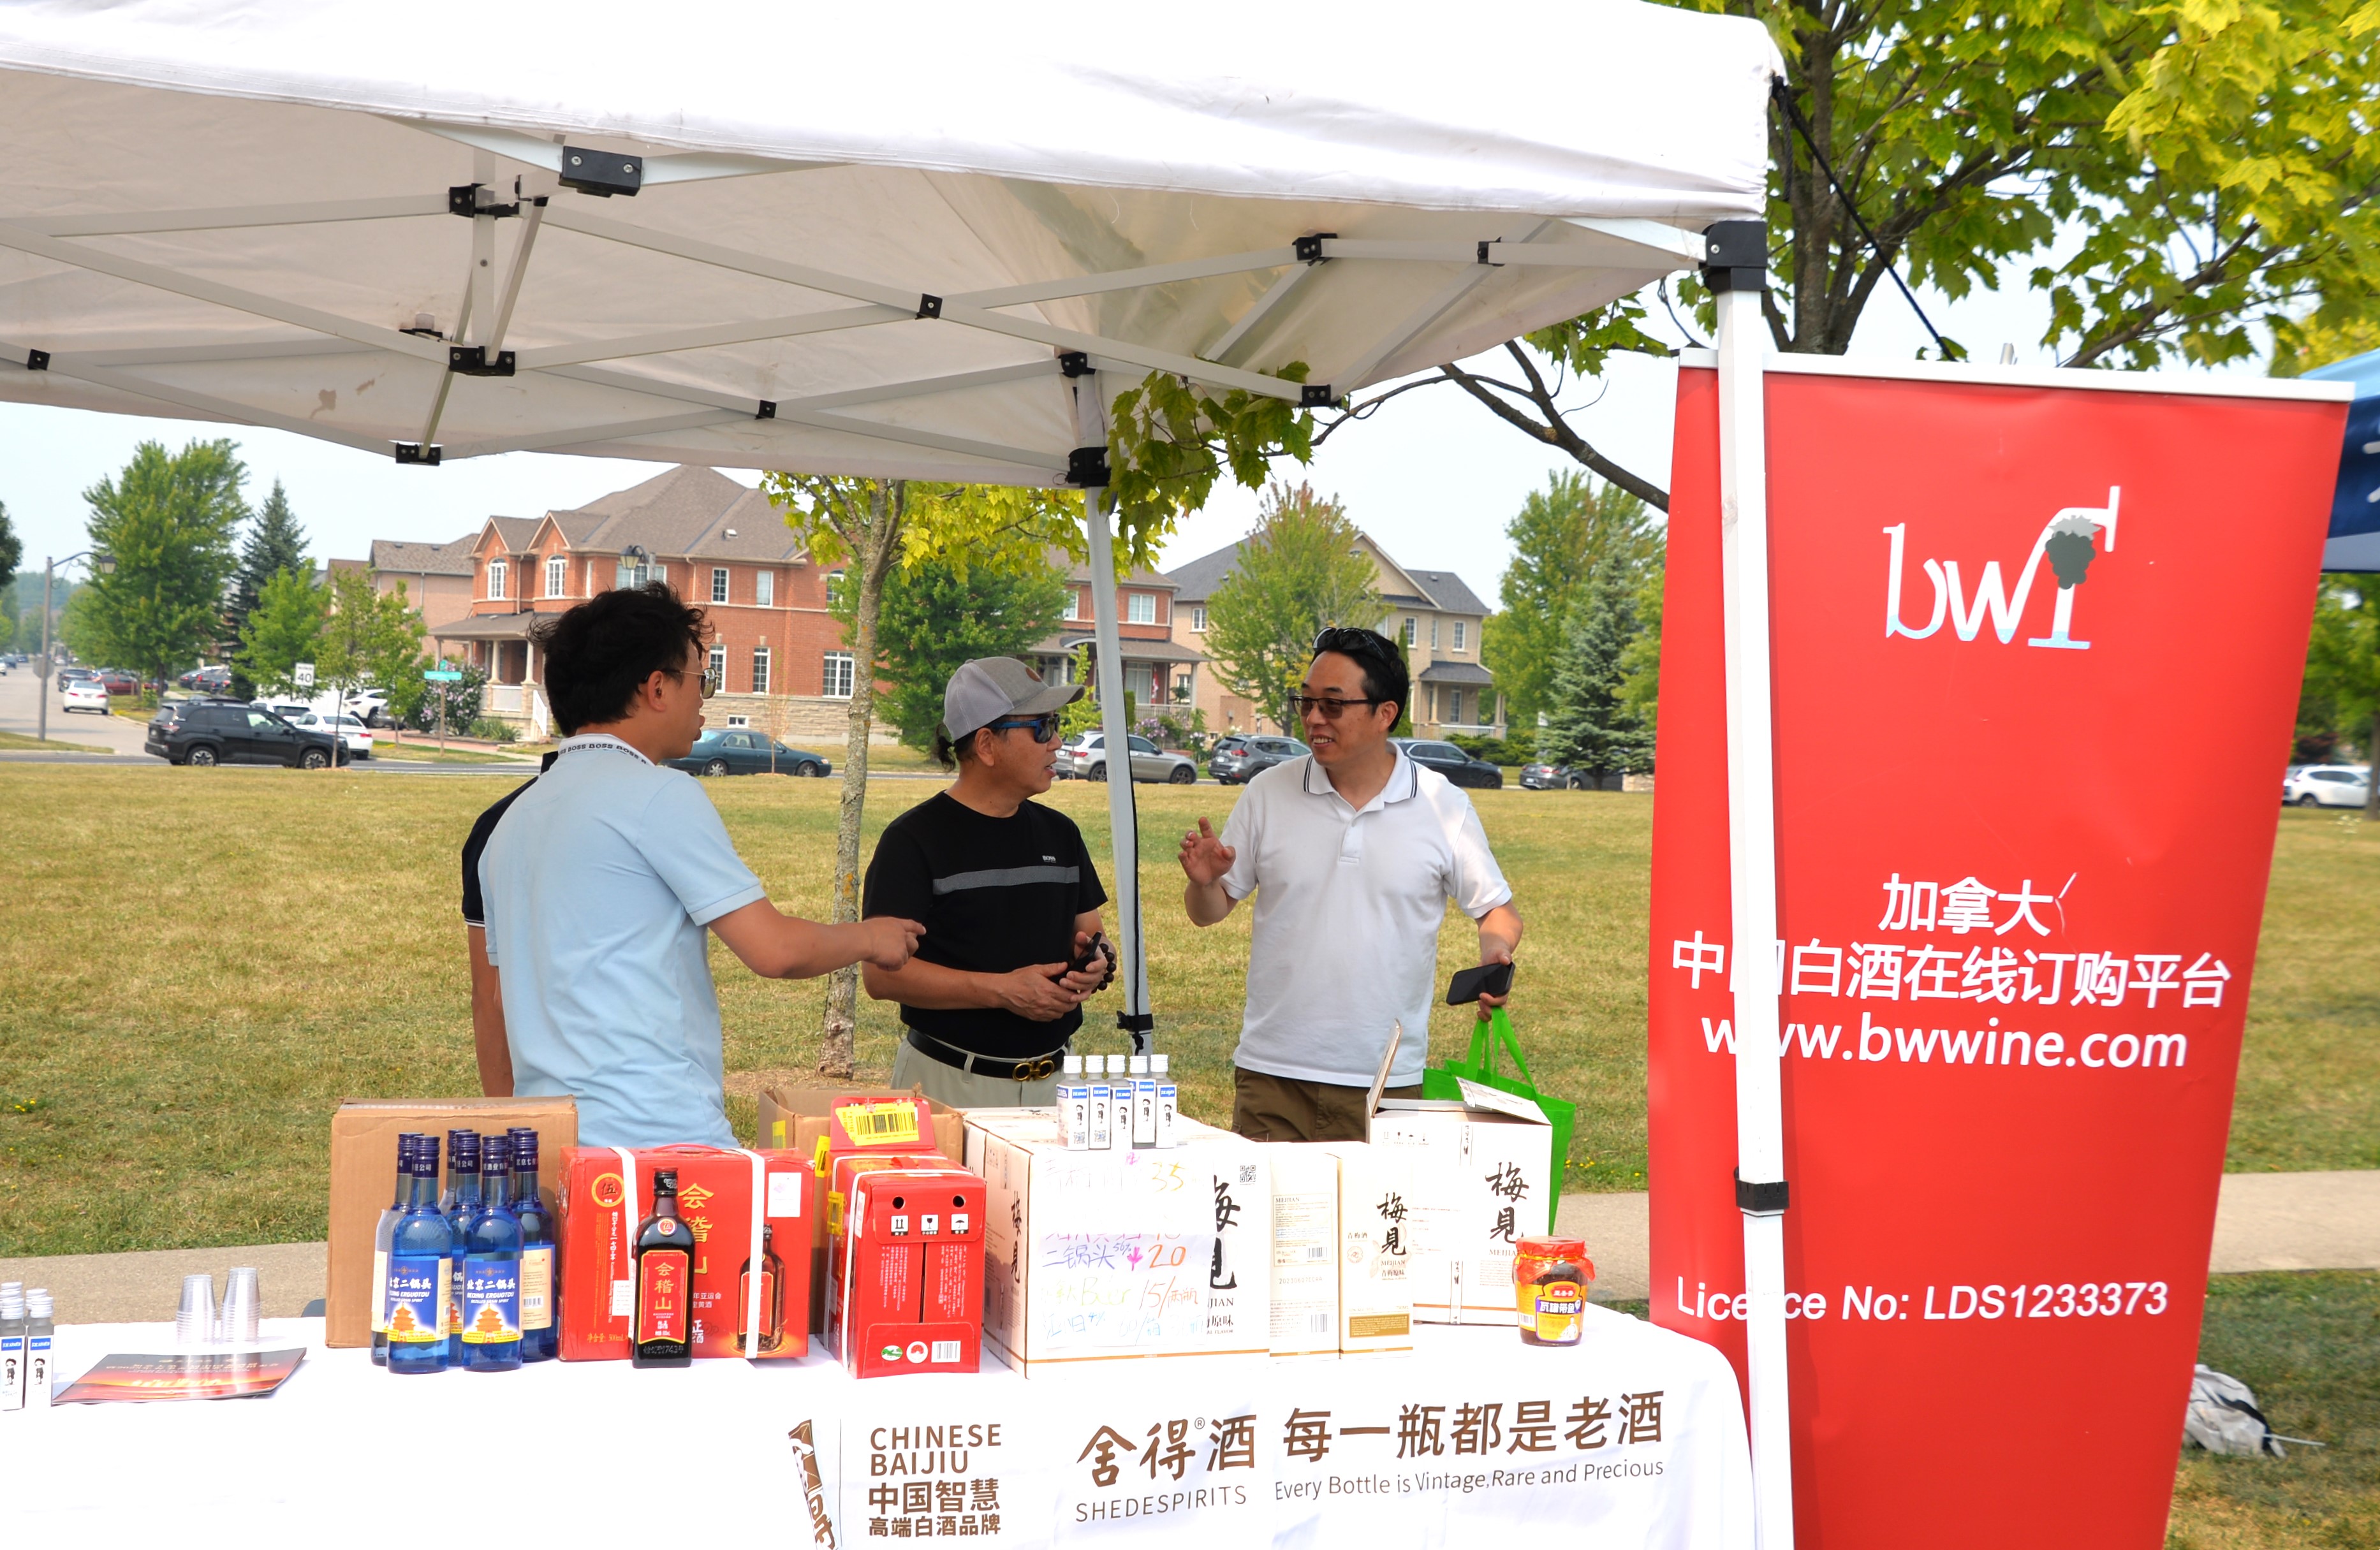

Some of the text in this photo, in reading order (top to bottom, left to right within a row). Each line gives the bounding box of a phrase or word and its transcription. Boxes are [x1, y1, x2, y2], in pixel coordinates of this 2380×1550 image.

[297, 673, 312, 684] 40
[1878, 872, 2053, 937] 加拿大
[1671, 930, 2231, 1009] 中白酒在线订购平台
[1150, 1160, 1189, 1193] 35
[1042, 1243, 1115, 1270] 二锅头
[1148, 1244, 1187, 1269] 20
[1488, 1248, 1517, 1257] MEIJIA
[467, 1278, 516, 1290] 北京二锅头
[654, 1262, 675, 1311] 会稽山
[1677, 1275, 2168, 1321] Licece No: LDS1233373
[870, 1423, 1002, 1451] CHINESE
[1282, 1390, 1664, 1463] 每一瓶都是老酒
[870, 1450, 969, 1477] BAIJIU
[1275, 1478, 1322, 1501] Every
[1329, 1473, 1390, 1495] Bottle
[1397, 1473, 1411, 1493] is
[1540, 1464, 1576, 1484] and
[1583, 1458, 1664, 1482] Precious
[868, 1478, 1000, 1516] 中国智慧
[1075, 1485, 1247, 1523] SHEDESPIRITS
[868, 1513, 1002, 1538] 高端白酒品牌
